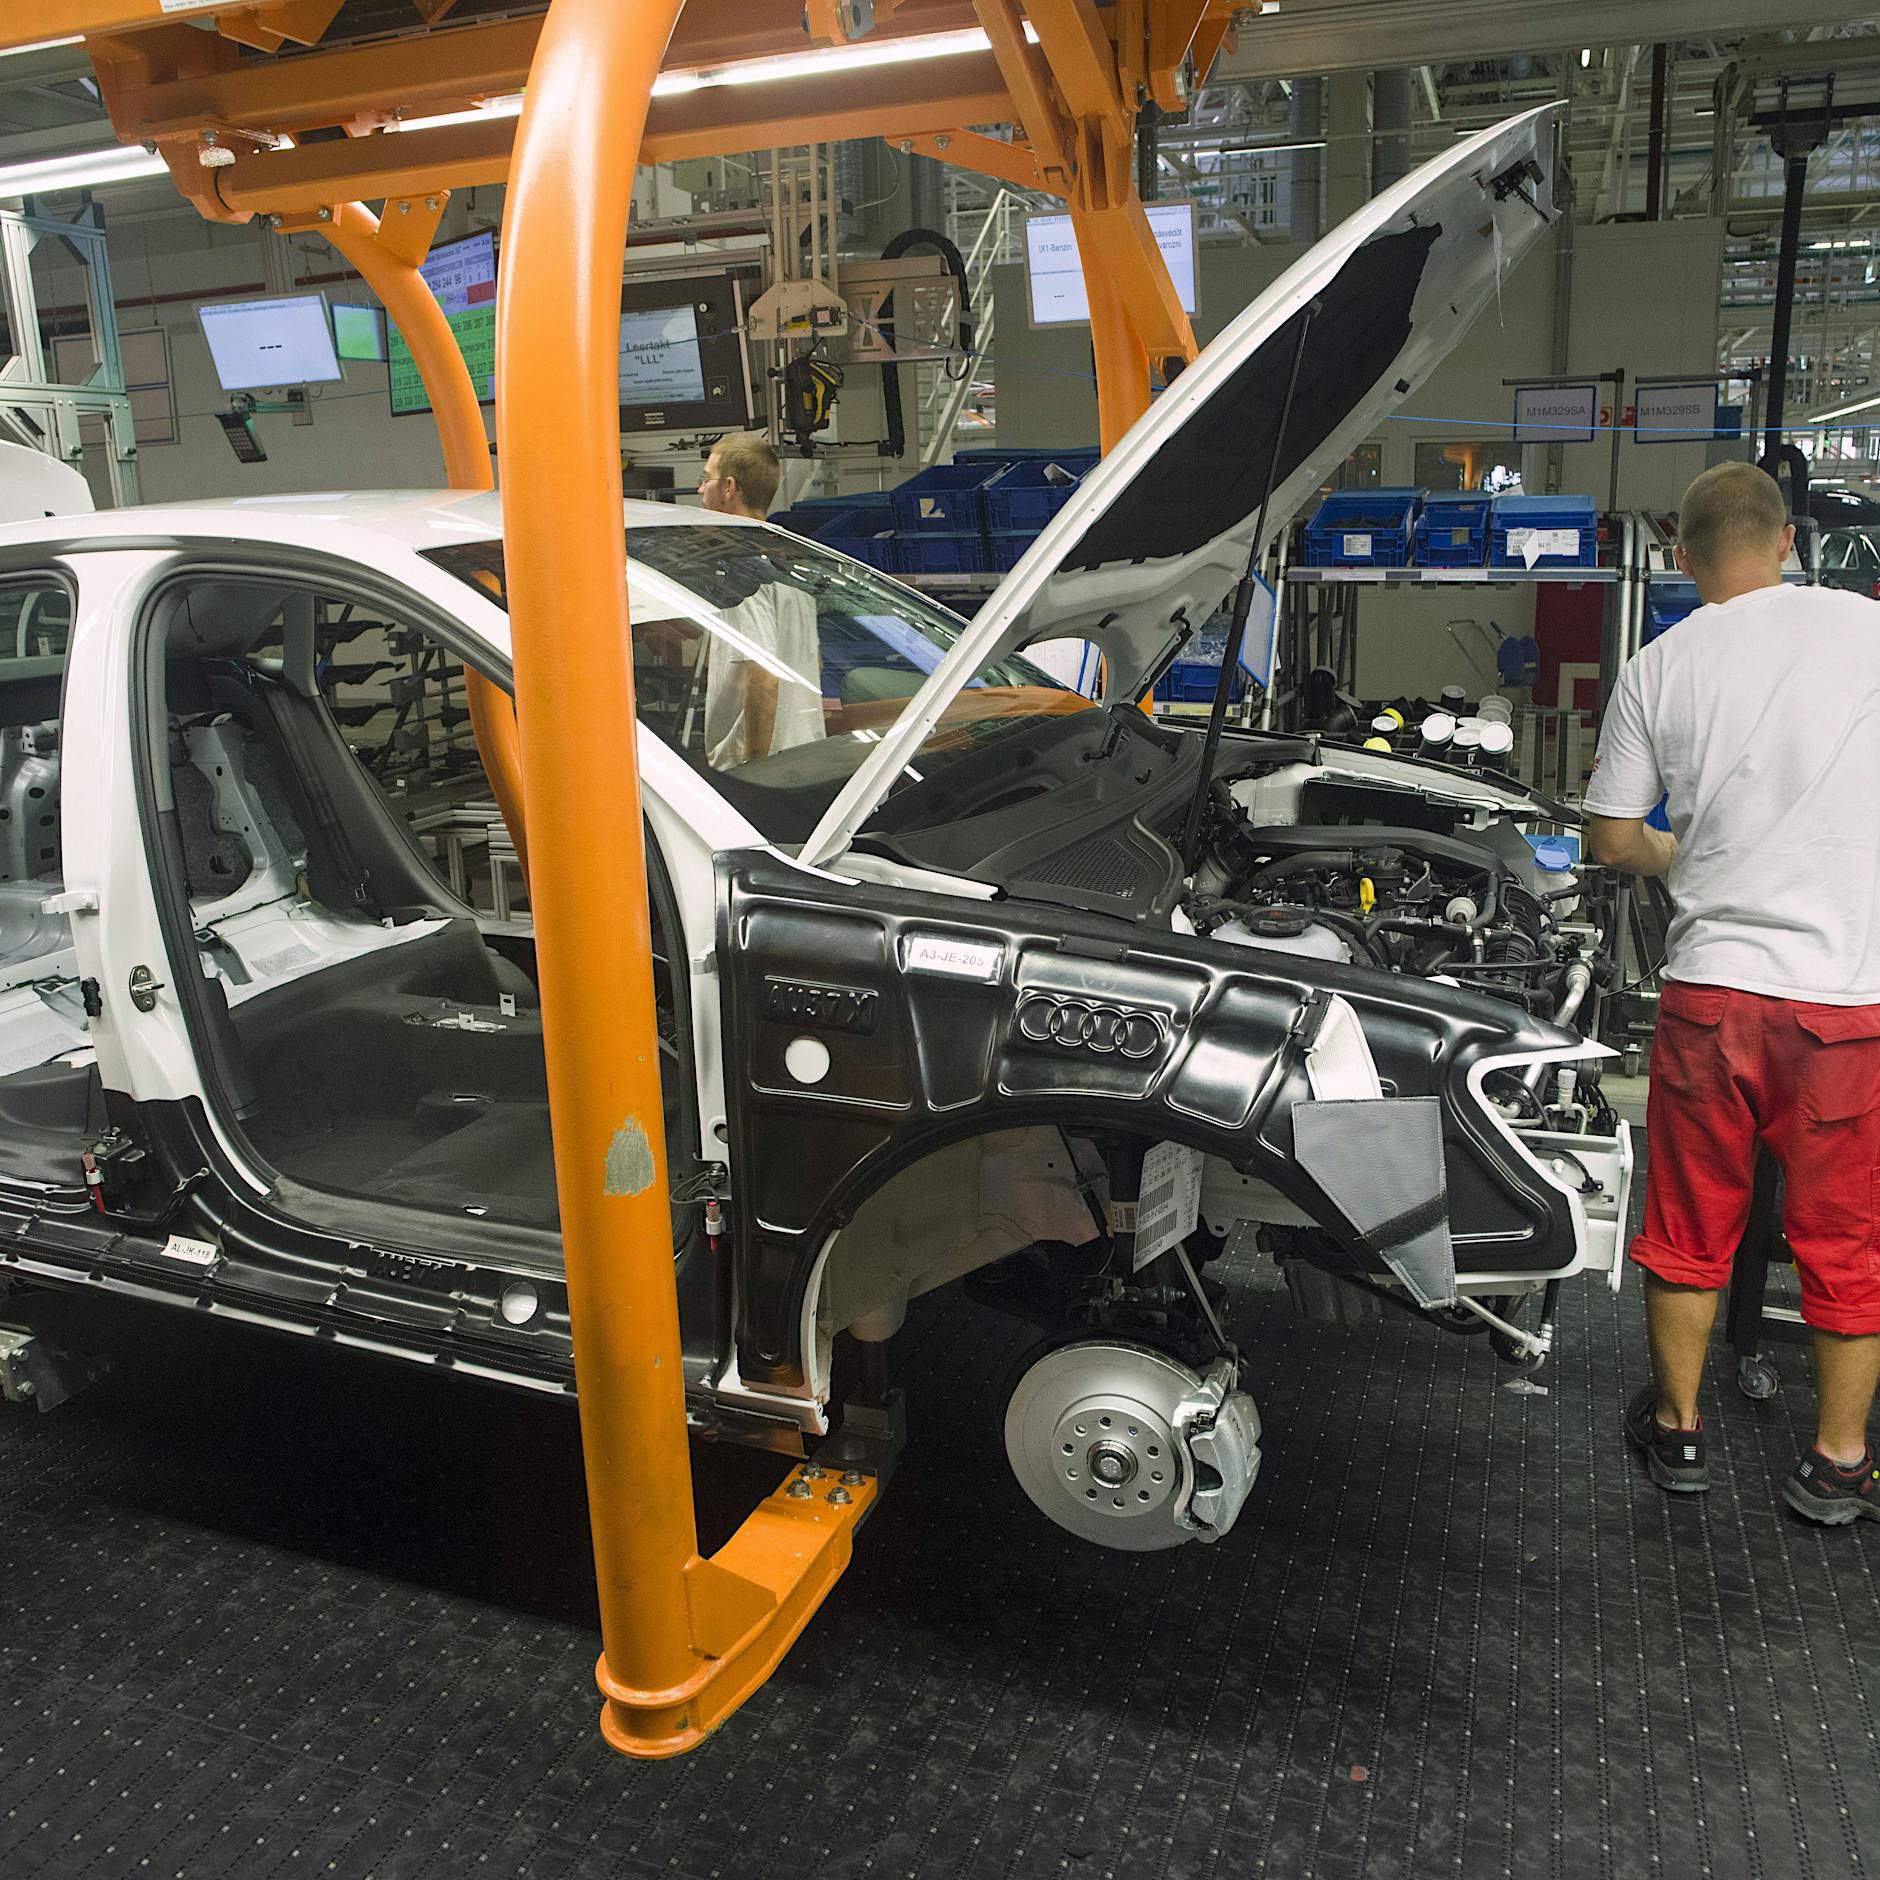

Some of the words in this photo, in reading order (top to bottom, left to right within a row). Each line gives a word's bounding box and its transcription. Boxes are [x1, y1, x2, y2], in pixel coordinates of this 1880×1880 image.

[626, 340, 671, 352] Leertakt
[1526, 405, 1586, 417] M1M329SA
[1640, 404, 1700, 417] M1M329SB
[919, 948, 984, 967] A3-JE-205
